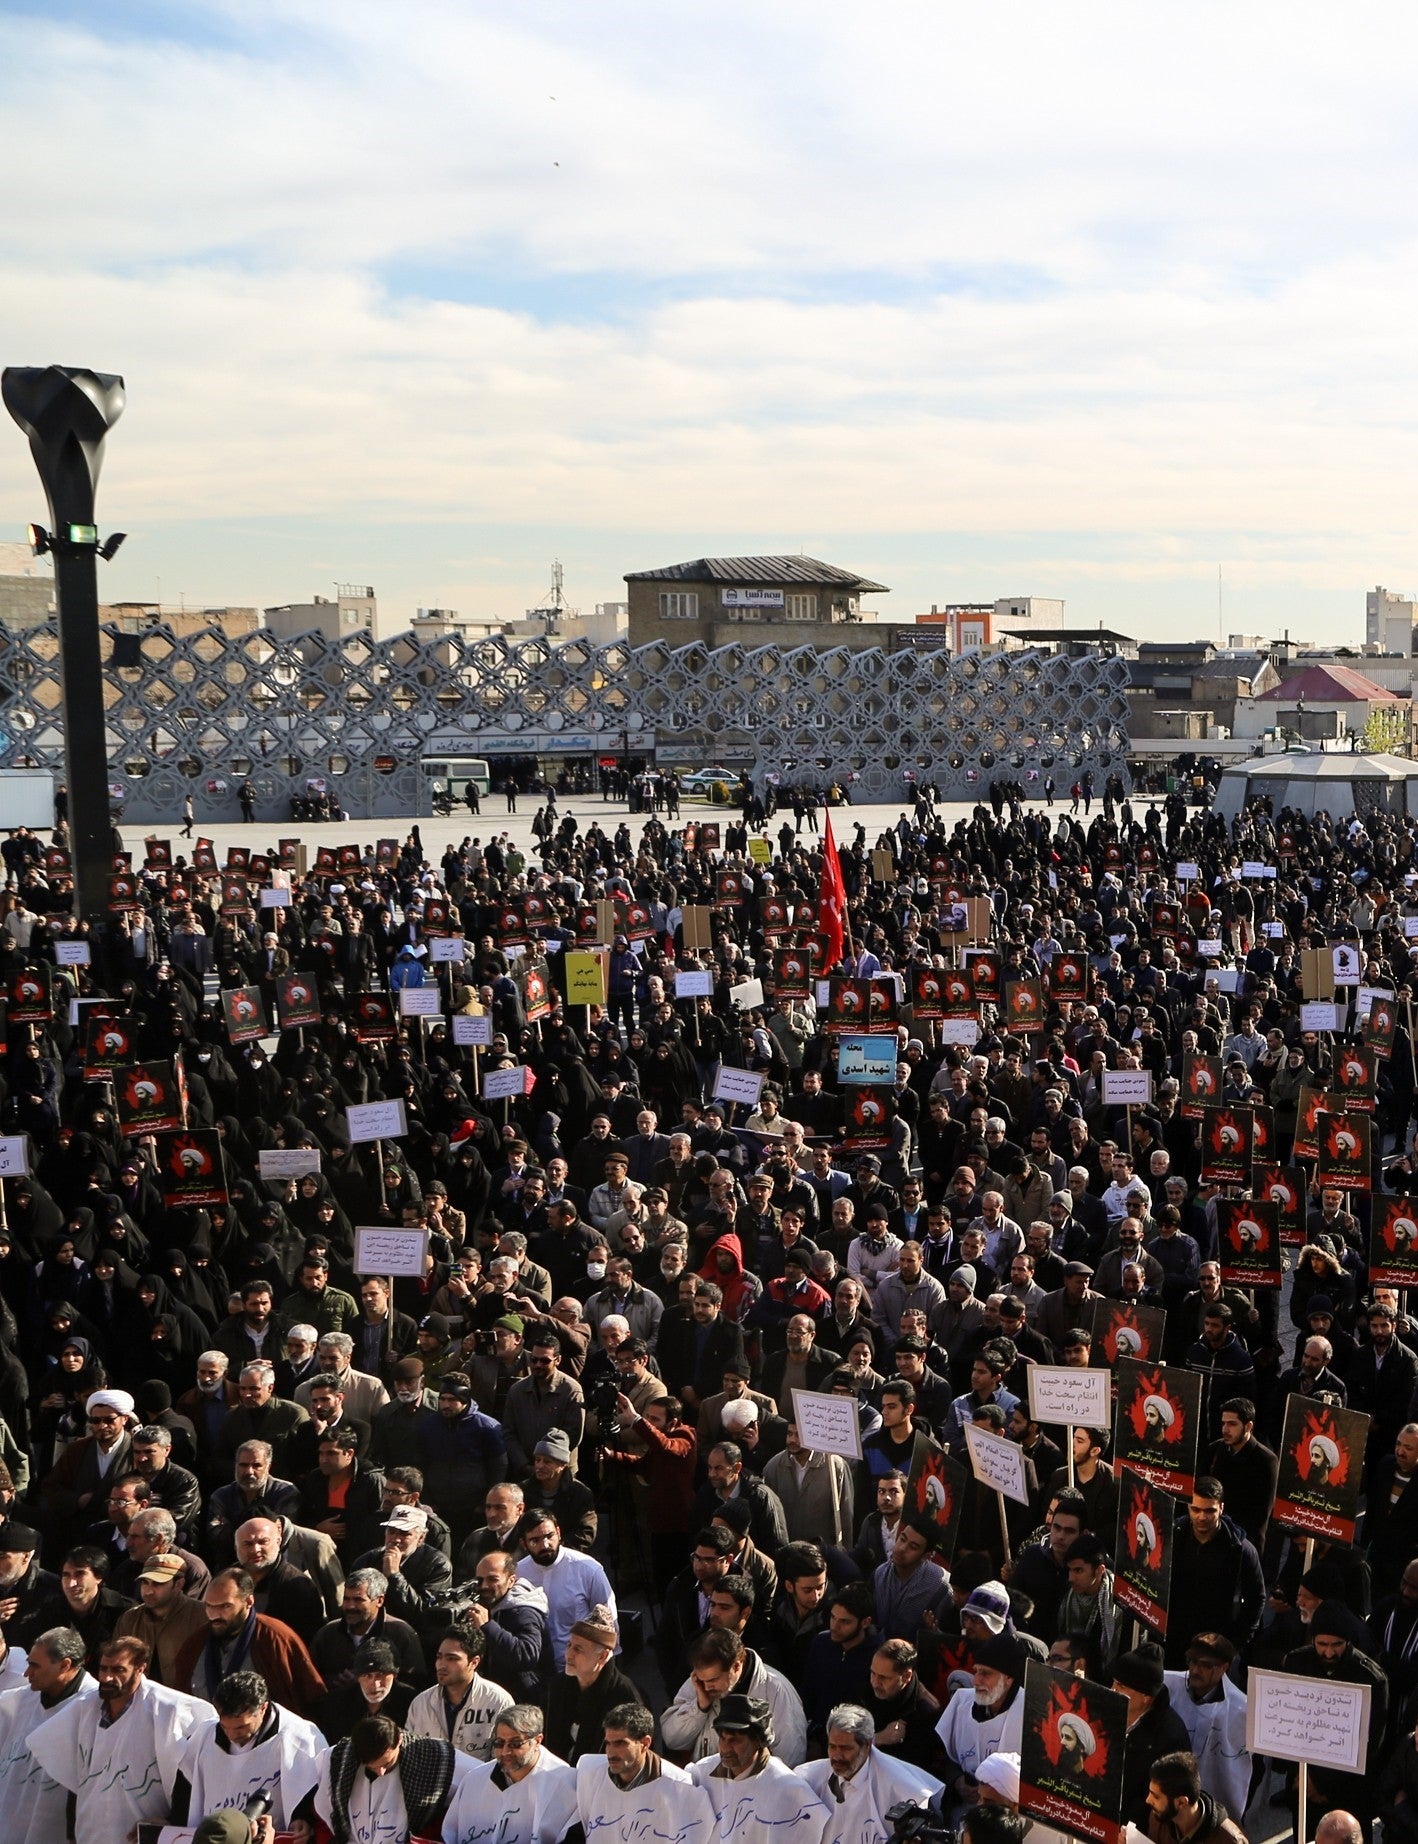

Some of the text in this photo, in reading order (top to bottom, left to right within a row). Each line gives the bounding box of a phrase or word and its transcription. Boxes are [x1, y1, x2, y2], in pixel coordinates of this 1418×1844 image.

[846, 1043, 863, 1052] محله
[842, 1063, 890, 1076] شهید اسدی
[1040, 1376, 1097, 1390] آل سعود خبیث
[1039, 1388, 1098, 1402] انتقام سخت خدا
[1045, 1402, 1090, 1415] در راه است.
